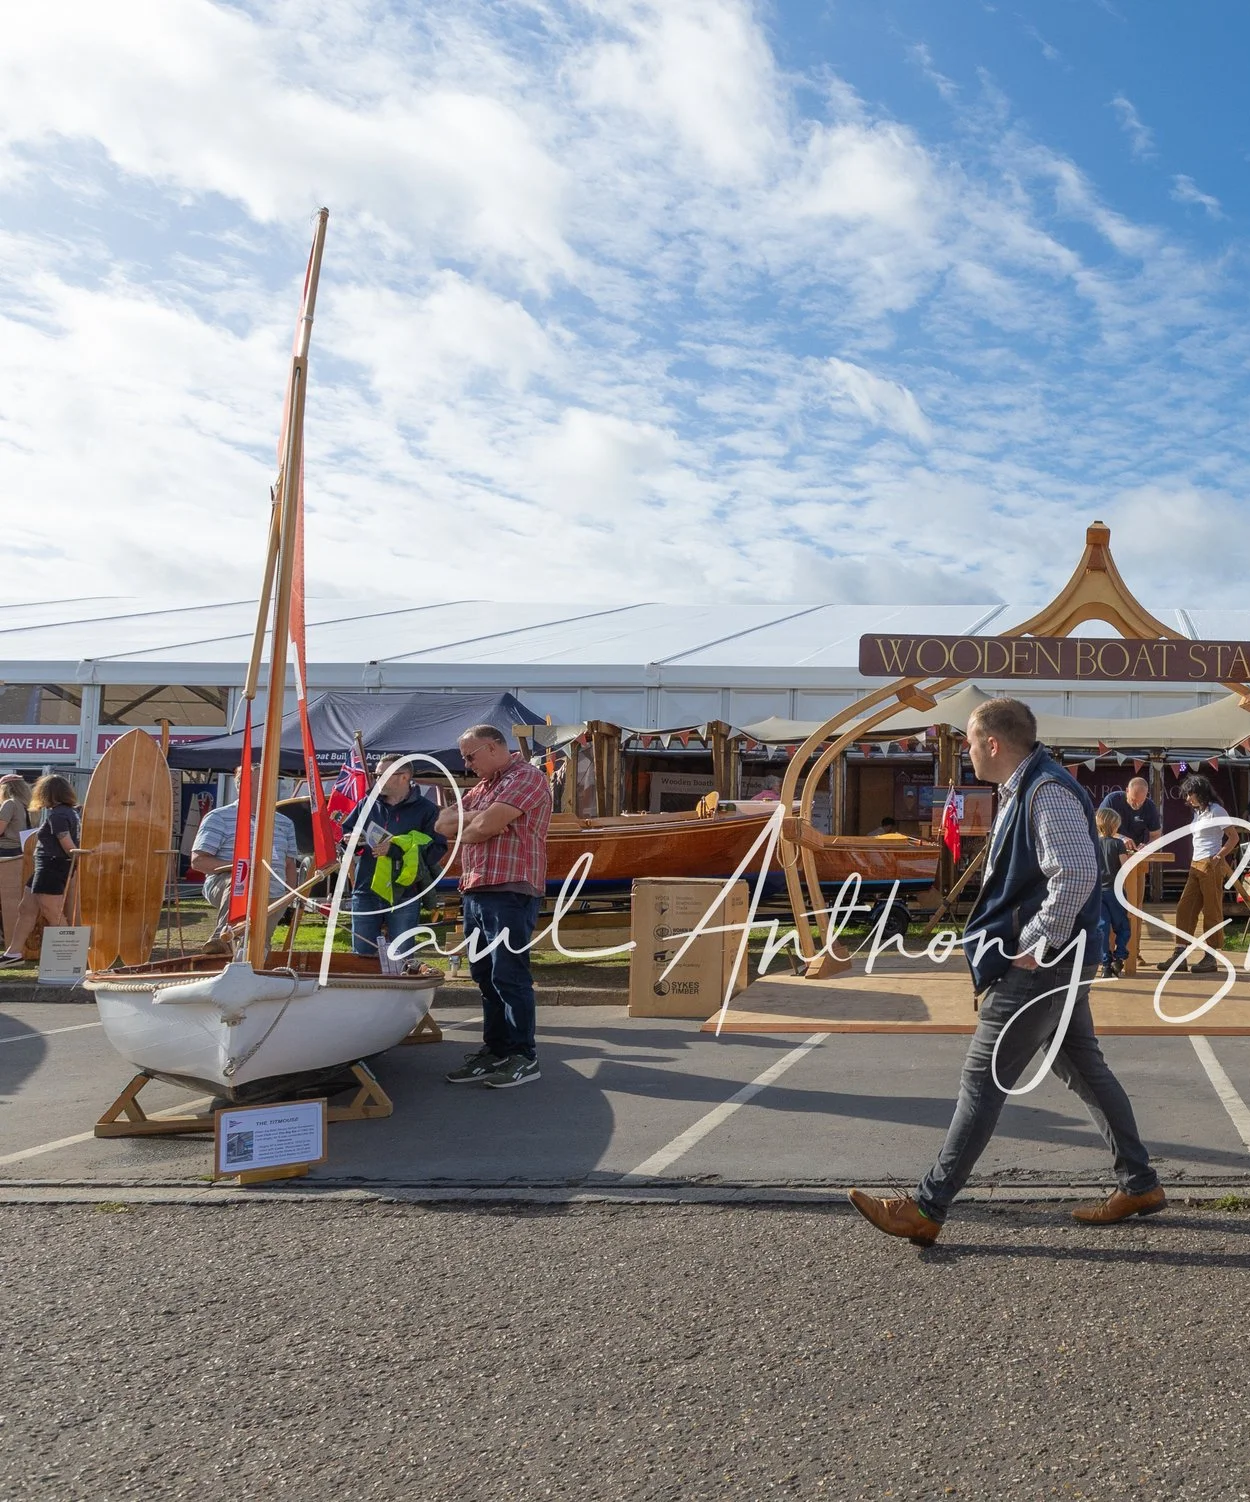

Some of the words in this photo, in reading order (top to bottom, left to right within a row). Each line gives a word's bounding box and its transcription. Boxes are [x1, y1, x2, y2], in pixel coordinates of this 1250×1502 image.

[873, 637, 1063, 676] WOODEN
[1075, 641, 1177, 679] BOAT
[0, 738, 33, 749] WAVE
[36, 738, 70, 749] HALL
[315, 752, 330, 761] oat
[661, 778, 691, 787] Wooden
[671, 981, 700, 989] SYKES
